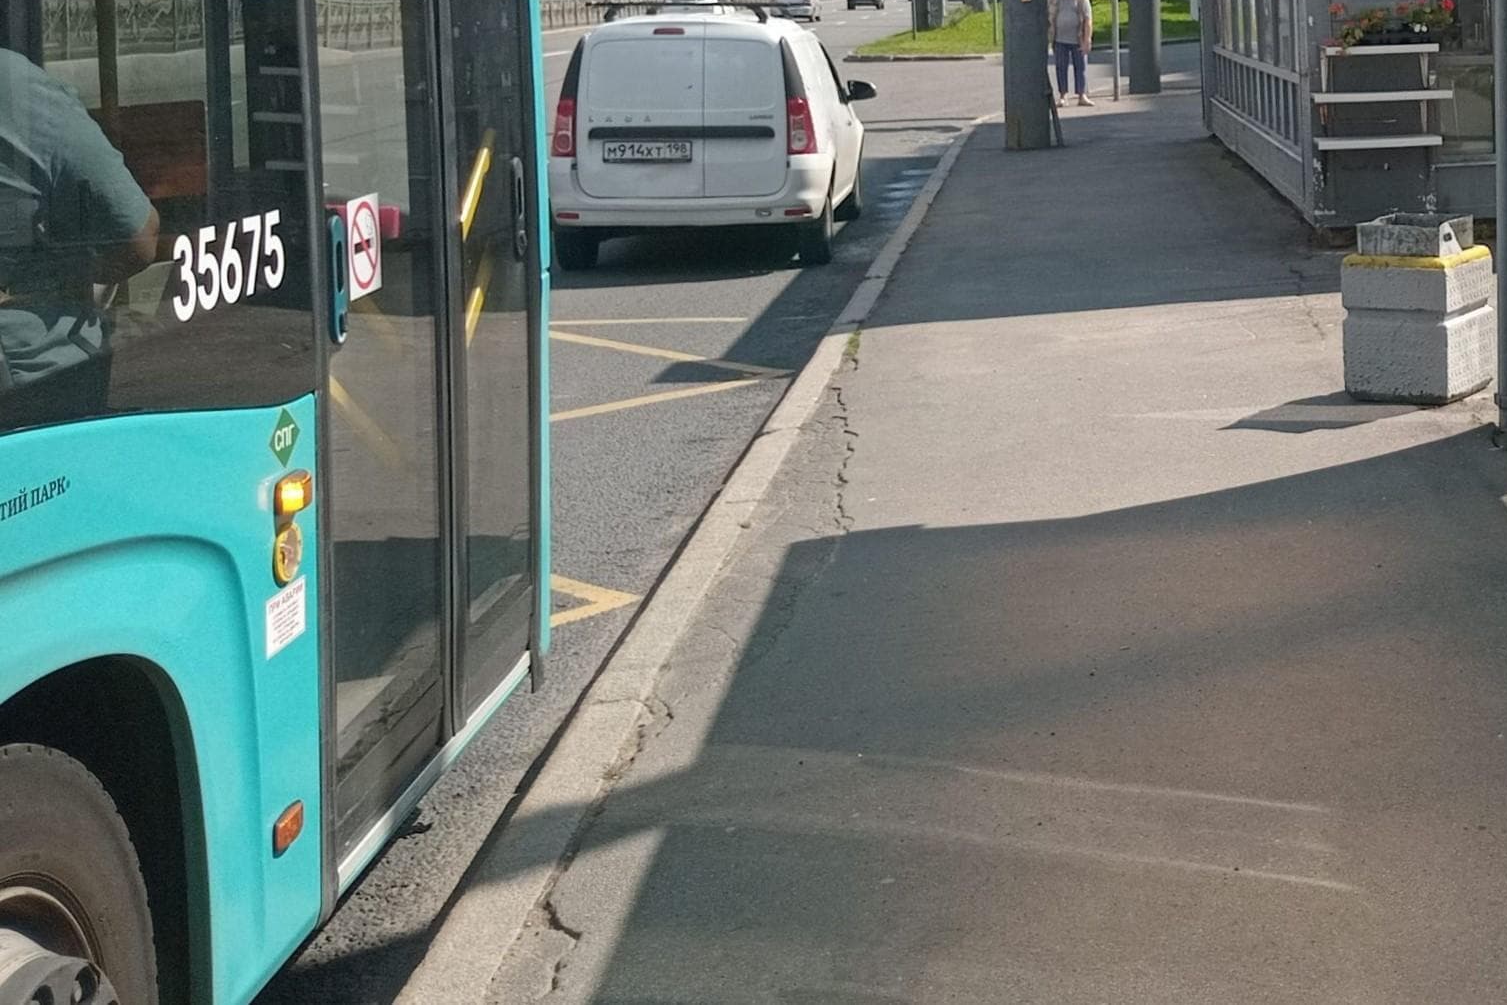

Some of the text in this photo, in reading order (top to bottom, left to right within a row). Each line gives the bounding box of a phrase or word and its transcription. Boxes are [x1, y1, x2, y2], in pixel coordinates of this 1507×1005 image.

[667, 143, 689, 154] 198
[172, 208, 286, 323] 35675
[274, 423, 296, 452] СПГ
